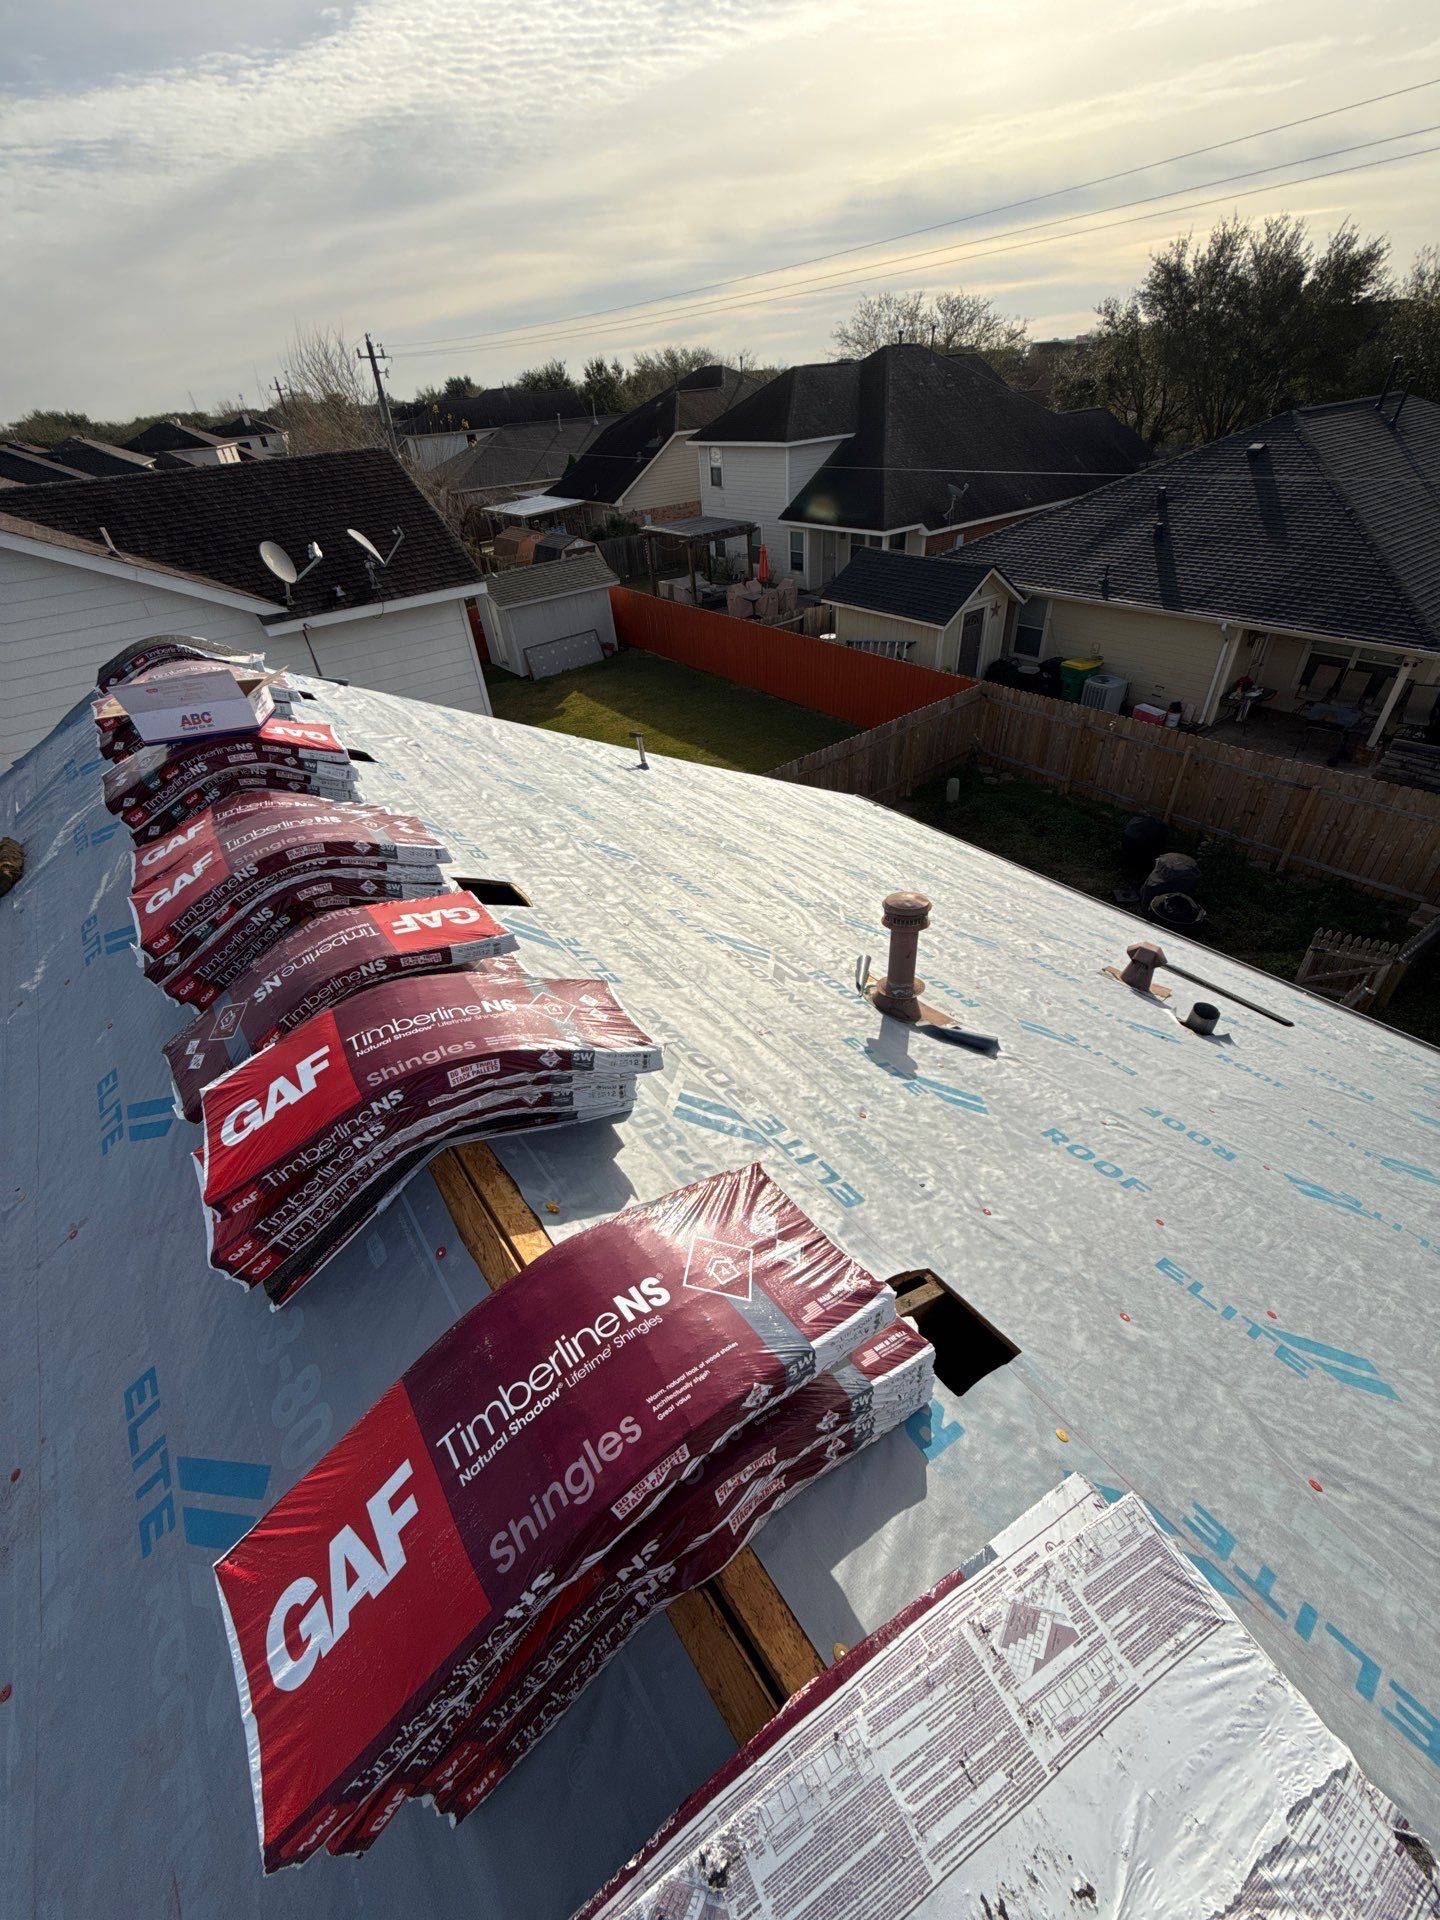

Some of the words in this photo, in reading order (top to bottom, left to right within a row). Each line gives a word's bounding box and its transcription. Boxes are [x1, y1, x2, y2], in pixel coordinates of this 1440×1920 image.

[180, 711, 213, 727] ABC
[265, 727, 328, 741] GAF
[180, 742, 254, 770] TimberlineNS
[130, 811, 145, 823] GAF
[142, 761, 208, 811] TimberlineNS
[141, 819, 206, 866] GAF
[222, 815, 341, 850] TimberlineNS
[145, 850, 213, 914] GAF
[170, 863, 259, 934] TimberlineNS
[80, 913, 102, 967] ELITE
[152, 933, 171, 949] GAF
[392, 908, 480, 935] GAF
[180, 980, 195, 995] GAF
[194, 906, 274, 978] TimberlineNS
[213, 914, 291, 987] TimberlineNS
[253, 921, 380, 1003] TimberlineNS
[556, 936, 623, 984] ELITE
[279, 959, 388, 1030] TimberlineNS
[346, 999, 518, 1051] TimberlineNS
[356, 1038, 392, 1058] Natural
[366, 1041, 477, 1087] Shingles
[450, 1070, 459, 1078] DO
[460, 1066, 473, 1075] NOT
[475, 1060, 498, 1071] TRIPLE
[452, 1073, 471, 1085] STACK
[472, 1065, 499, 1077] PALLETS
[573, 1052, 594, 1061] SW
[1216, 1053, 1291, 1092] ROOF
[96, 1066, 124, 1157] ELITE
[220, 1045, 330, 1147] GAF
[232, 1190, 258, 1214] GAF
[262, 1089, 404, 1188] TimberlineNS
[752, 1114, 866, 1208] ELITE
[1040, 1127, 1153, 1194] ROOF
[1139, 1107, 1238, 1163] ROOF
[228, 1241, 253, 1262] GAF
[255, 1121, 385, 1234] TimberlineNS
[252, 1254, 272, 1275] GAF
[1154, 1256, 1316, 1379] ELITE
[666, 1373, 686, 1390] natural
[685, 1366, 699, 1377] look
[704, 1352, 721, 1364] wood
[788, 1352, 814, 1376] SW
[459, 1435, 509, 1487] Natural
[613, 1315, 663, 1349] Shingles
[652, 1381, 694, 1413] Architecturally
[657, 1404, 675, 1421] Great
[675, 1394, 692, 1407] value
[851, 1393, 873, 1412] SW
[122, 1366, 176, 1560] ELITE
[615, 1498, 628, 1510] DO
[632, 1478, 651, 1495] NOT
[654, 1447, 686, 1475] TRIPLE
[489, 1415, 642, 1574] Shingles
[620, 1488, 650, 1516] STACK
[266, 1458, 420, 1692] GAF
[1182, 1502, 1440, 1769] ELITE
